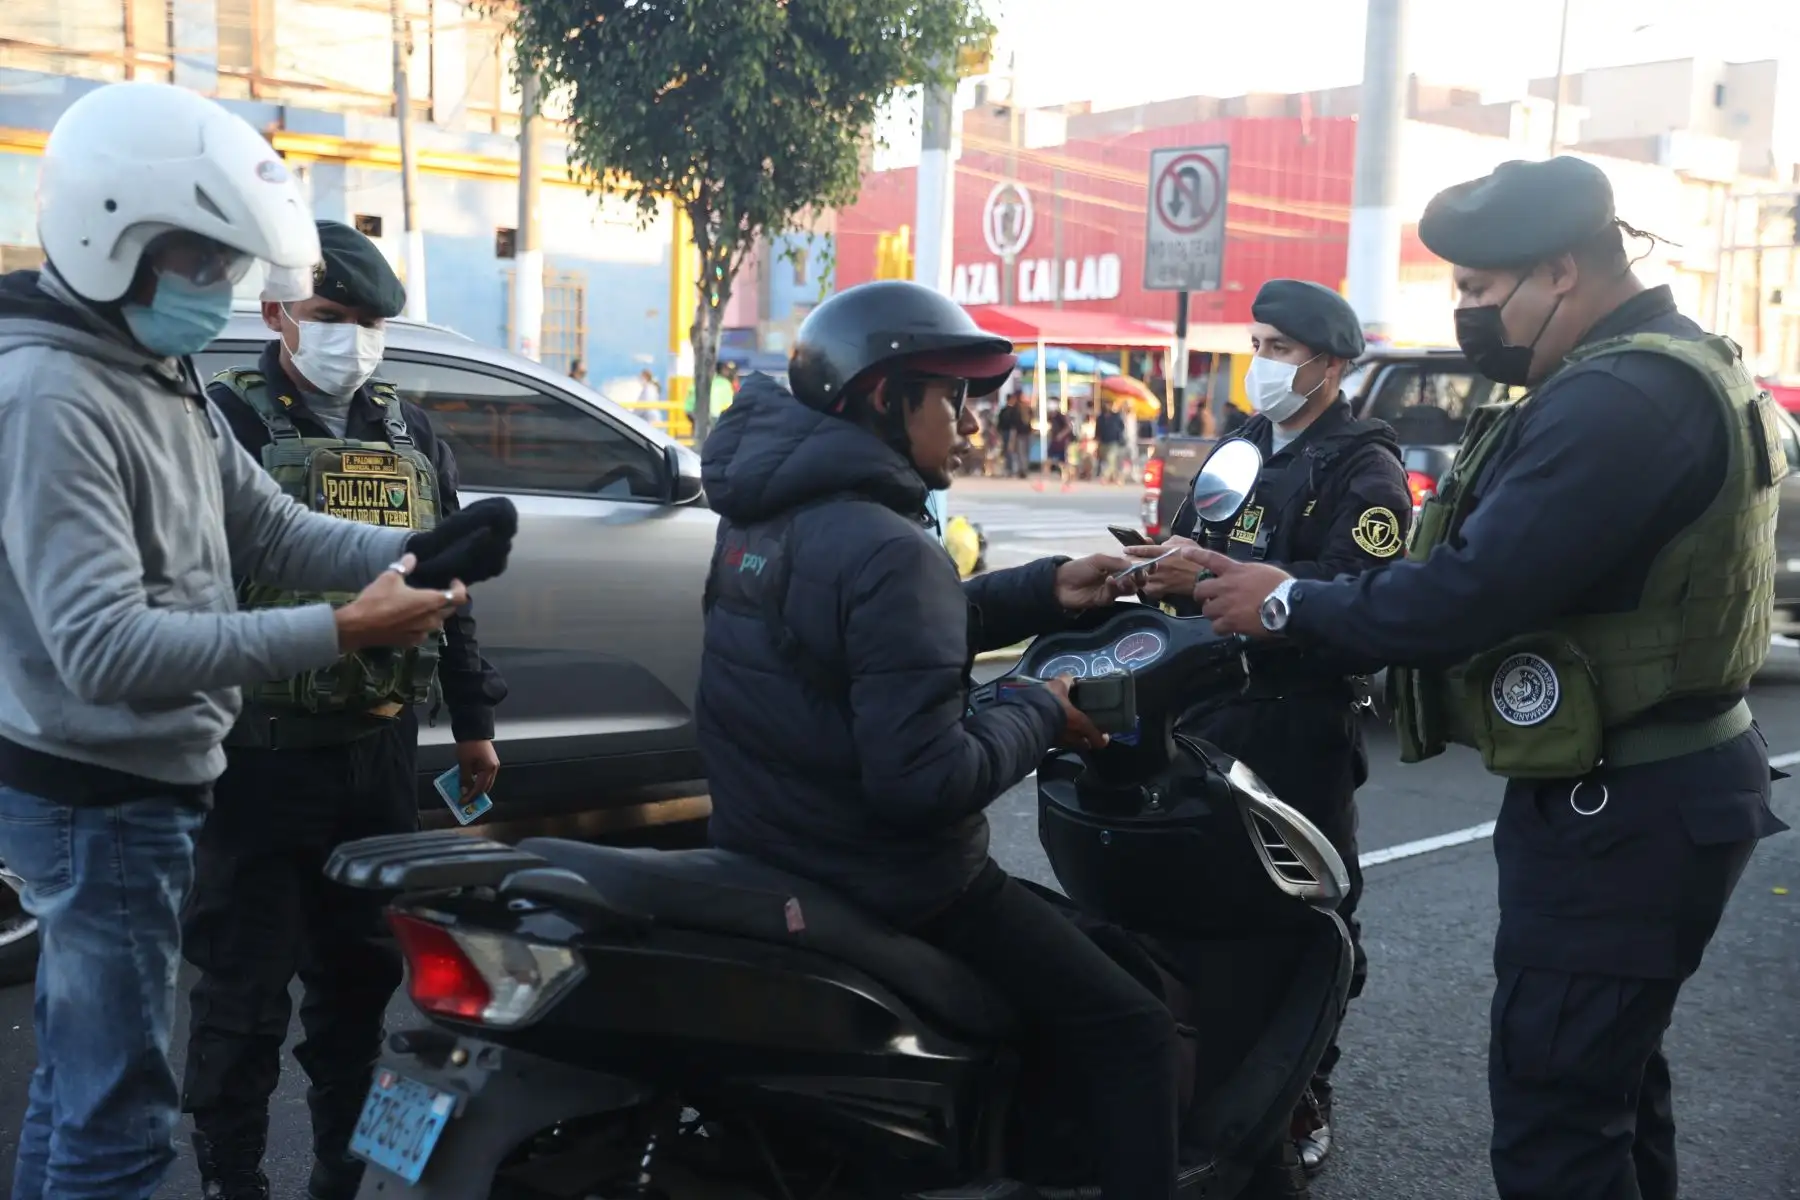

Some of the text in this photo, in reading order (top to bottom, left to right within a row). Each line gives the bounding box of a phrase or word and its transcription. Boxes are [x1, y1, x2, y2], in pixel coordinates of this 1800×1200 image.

[951, 262, 999, 305] AZA
[328, 479, 389, 508] POLICIA
[383, 510, 409, 526] VERDE
[1512, 697, 1552, 721] COMMAND
